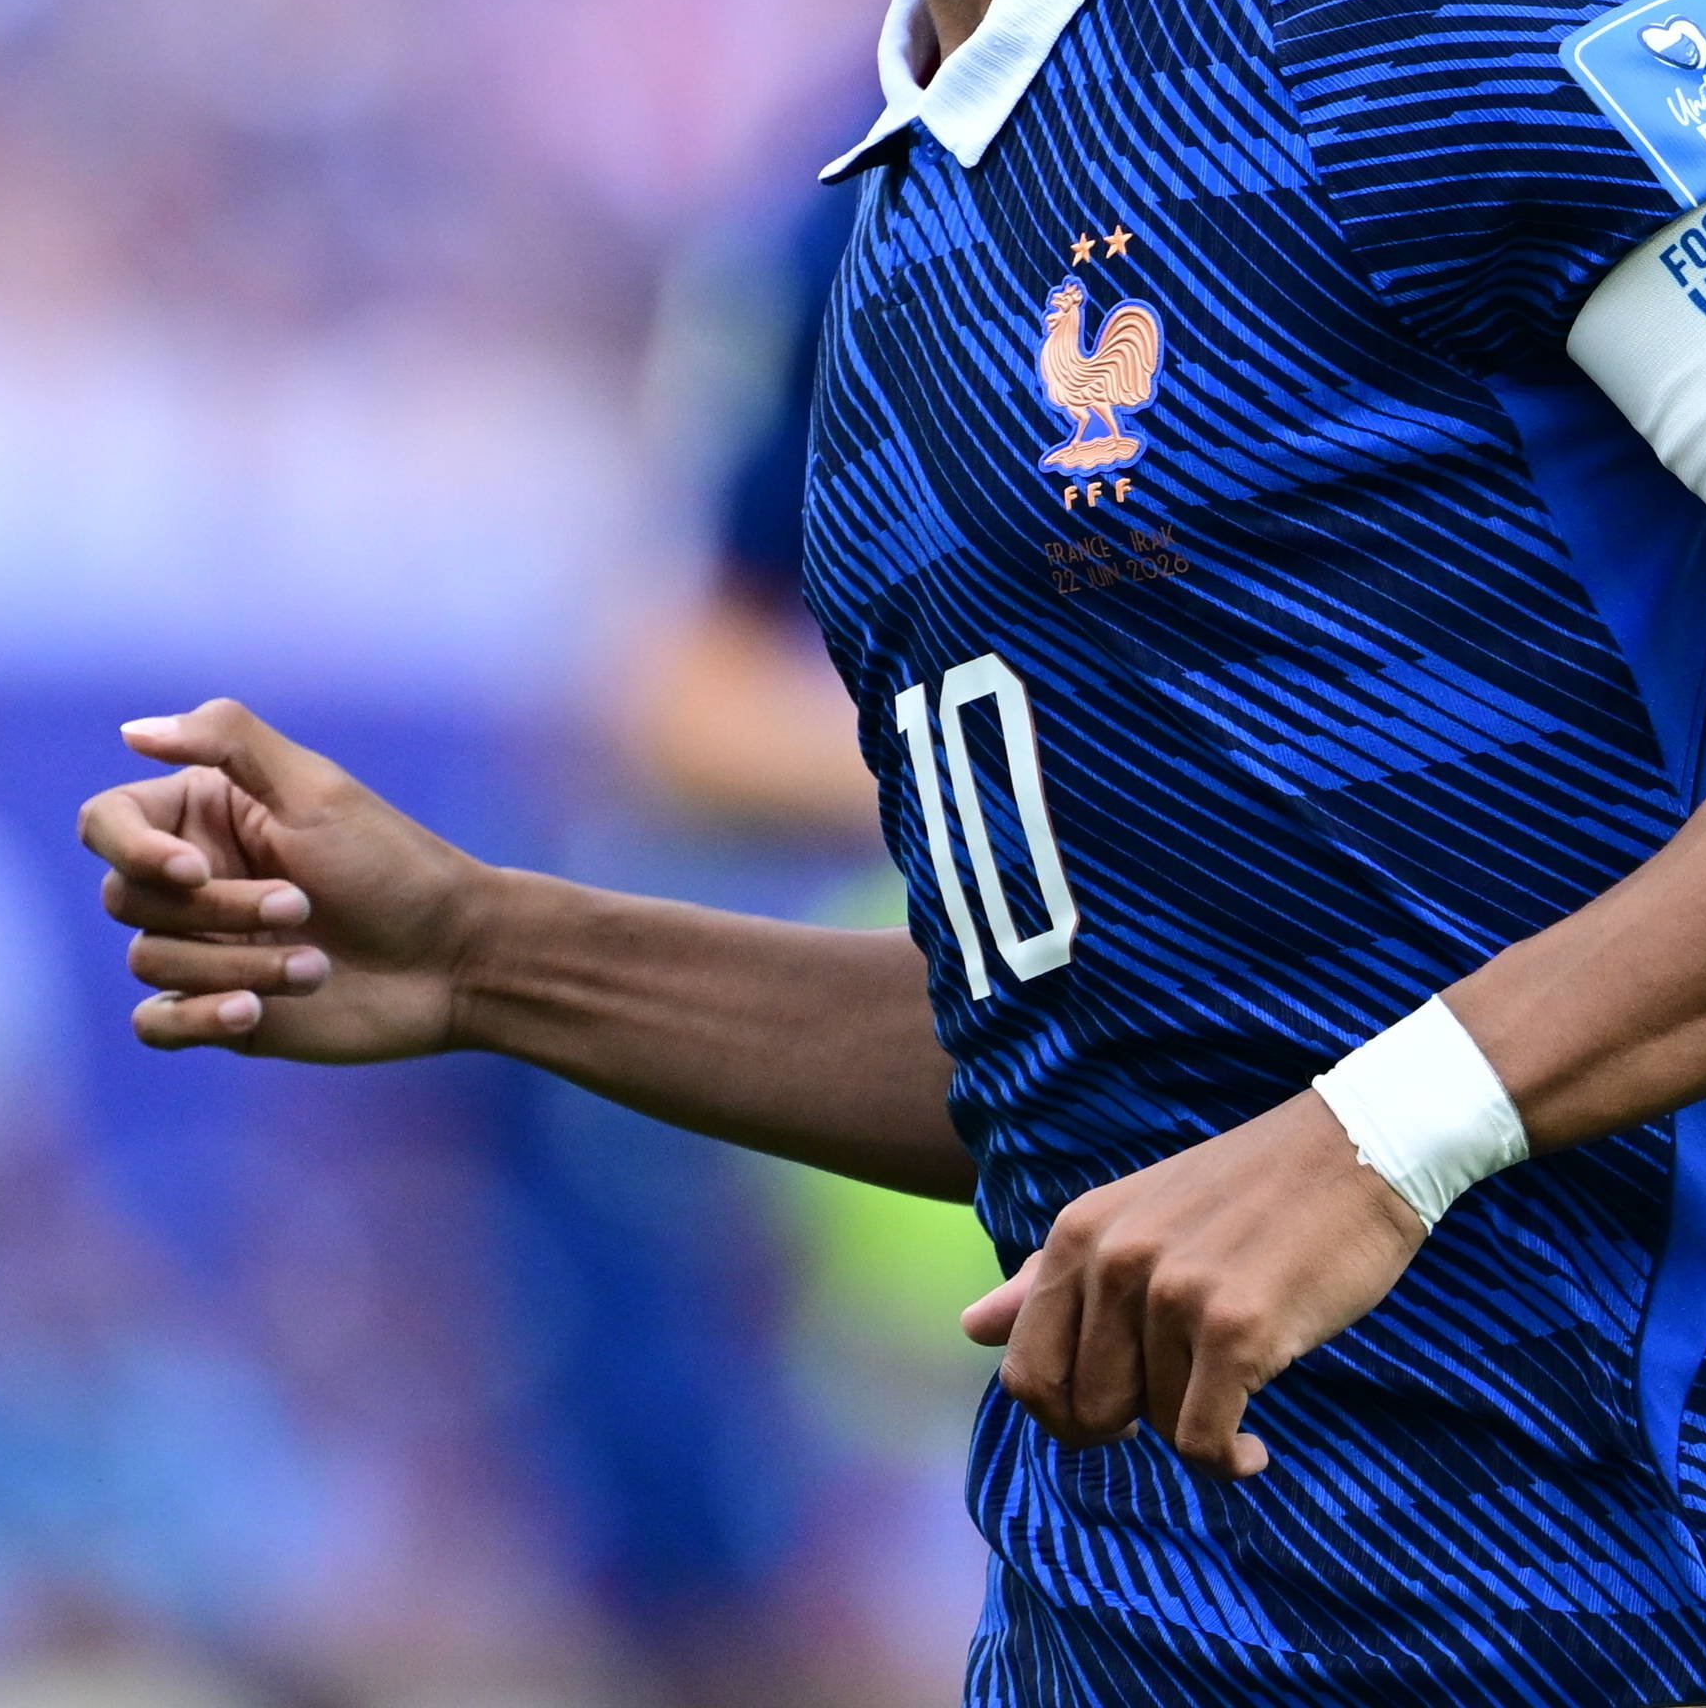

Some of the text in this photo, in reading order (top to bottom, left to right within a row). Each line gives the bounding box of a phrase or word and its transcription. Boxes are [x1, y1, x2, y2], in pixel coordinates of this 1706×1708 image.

[1044, 536, 1112, 566] FRANCE
[1129, 524, 1177, 553] IRAK
[1052, 552, 1189, 594] 22 JUIN 2026
[895, 652, 1080, 1001] 10
